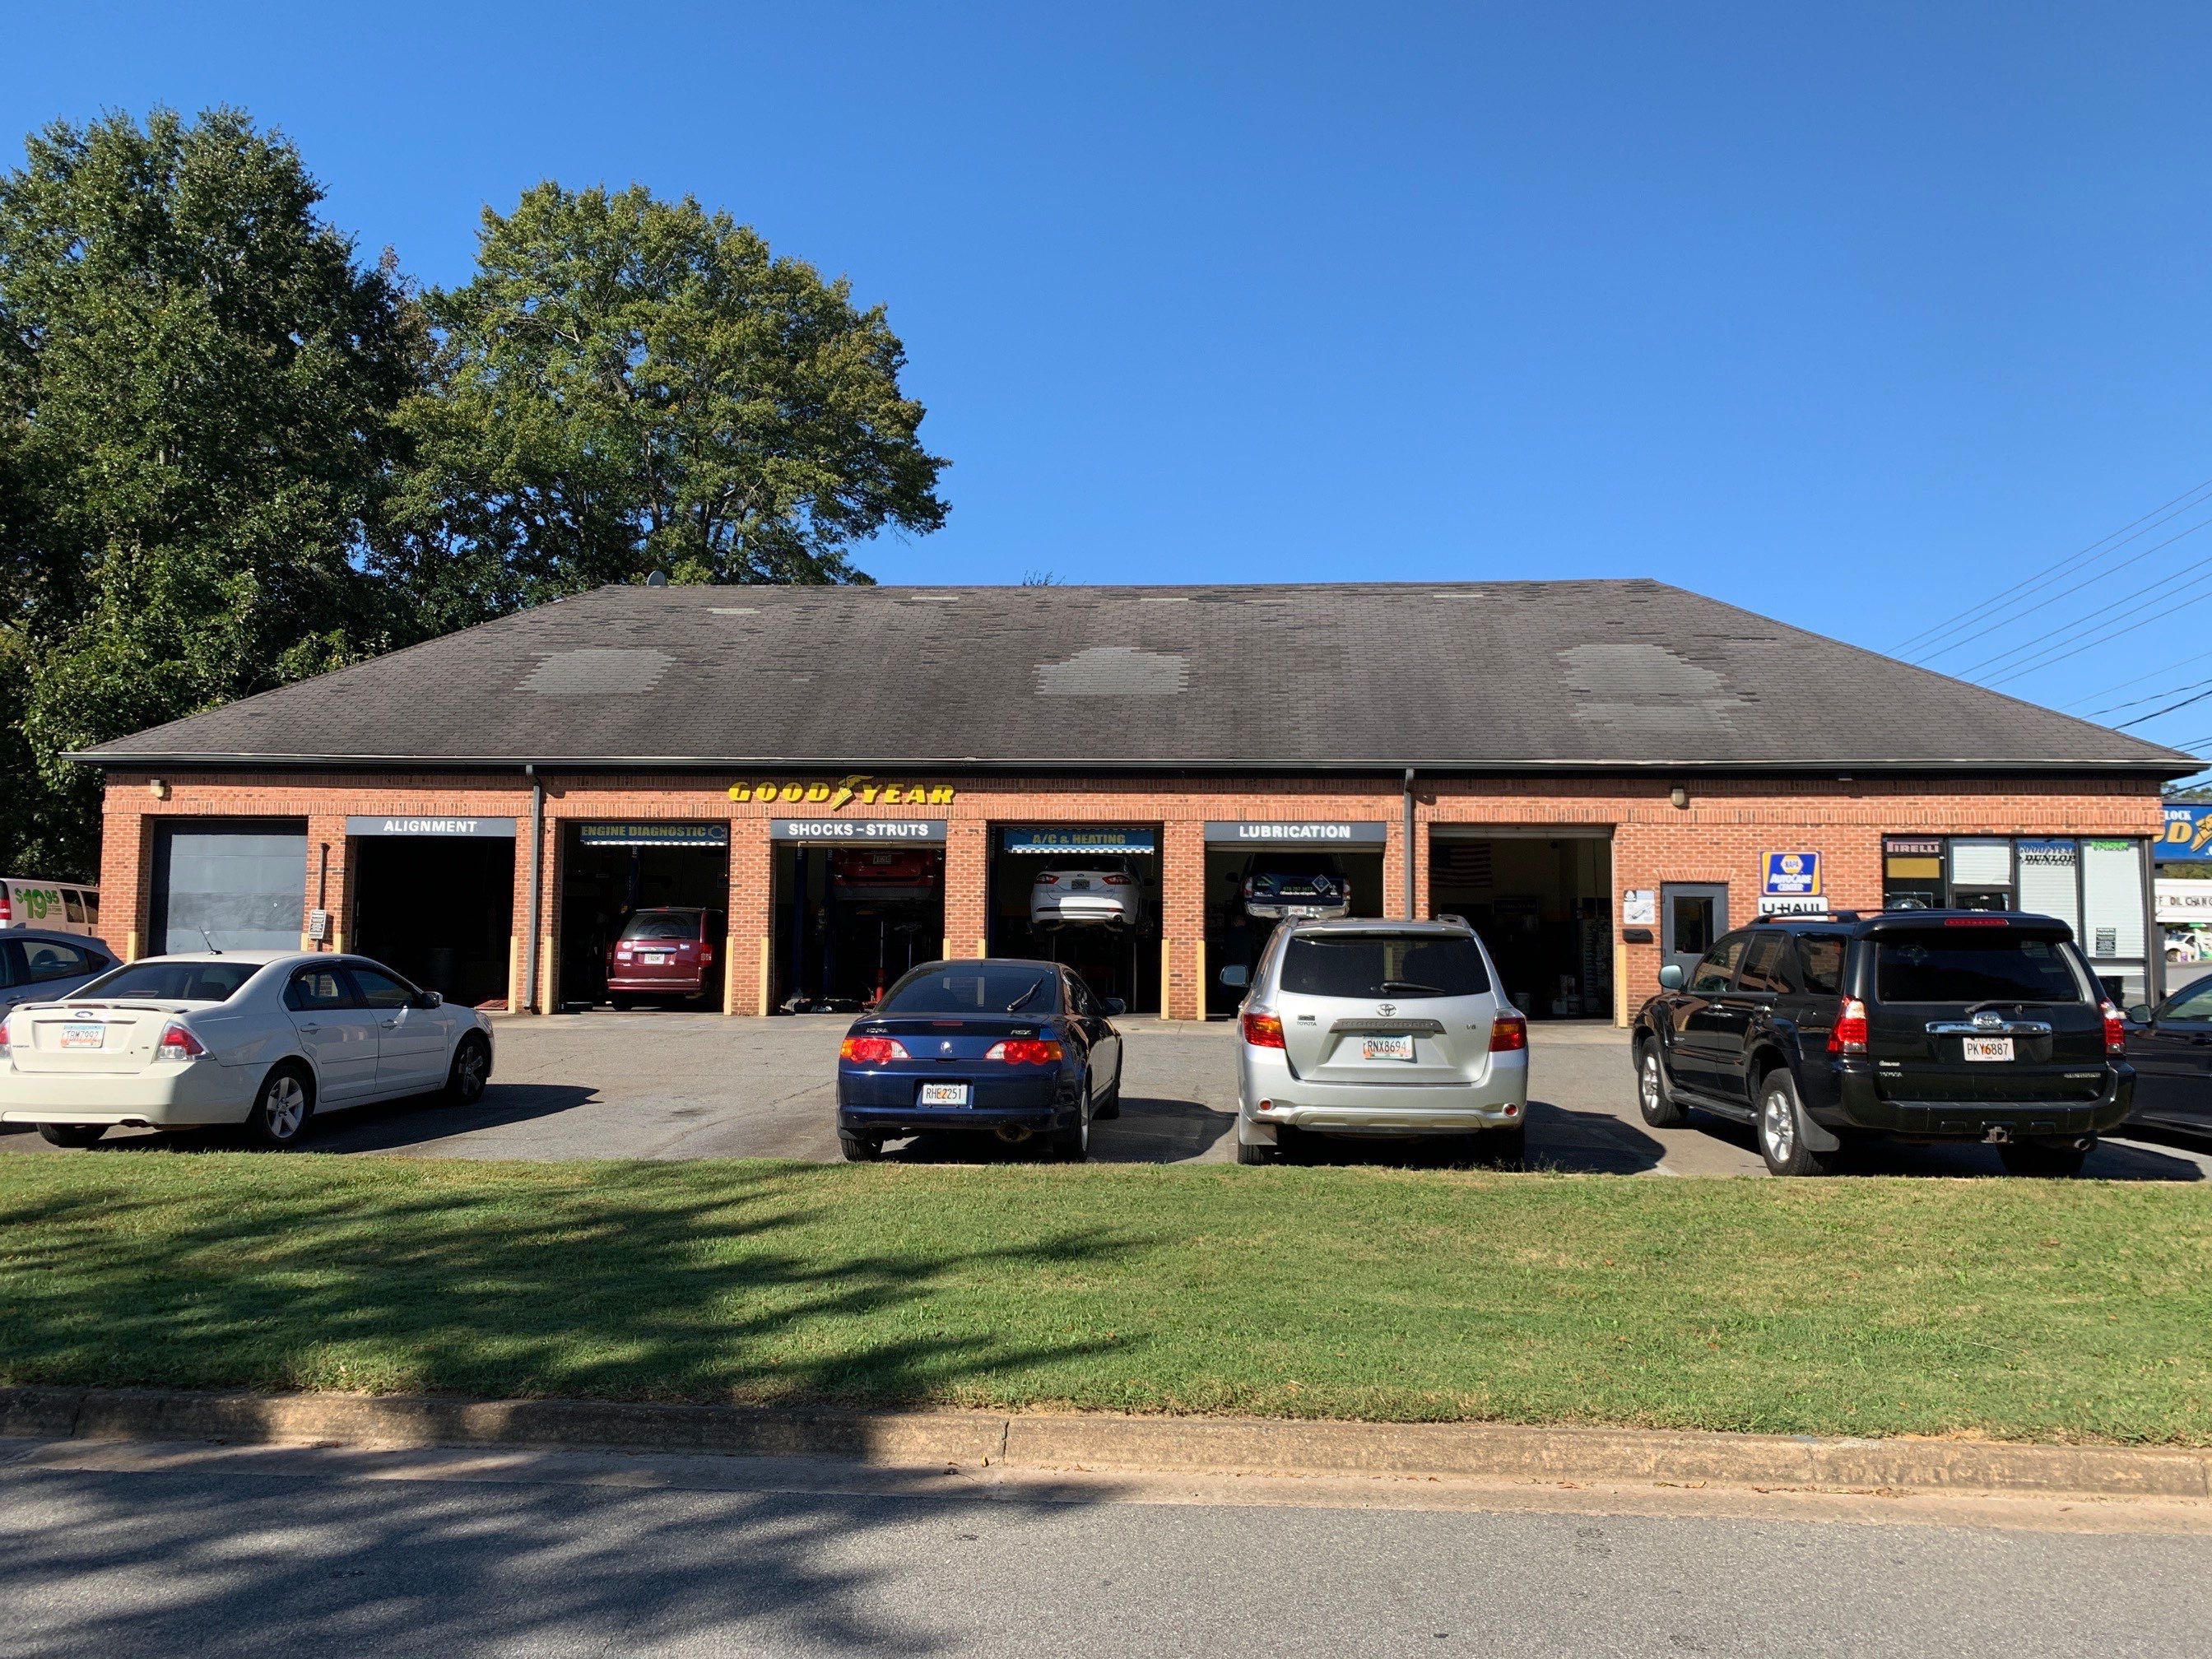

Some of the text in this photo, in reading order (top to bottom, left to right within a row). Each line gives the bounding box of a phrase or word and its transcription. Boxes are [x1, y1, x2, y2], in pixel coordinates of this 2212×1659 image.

[383, 820, 478, 833] ALIGNMENT
[581, 825, 706, 837] ENGINE DIAGNOSTIC
[1238, 825, 1351, 839] LUBRICATION
[1032, 834, 1057, 844] A/C
[1072, 834, 1127, 844] HEATING
[1886, 841, 1940, 853] PIRELLI
[1367, 1040, 1406, 1053] RNX8694
[1967, 1043, 2008, 1055] PKY6887
[926, 1087, 962, 1099] RHE2251
